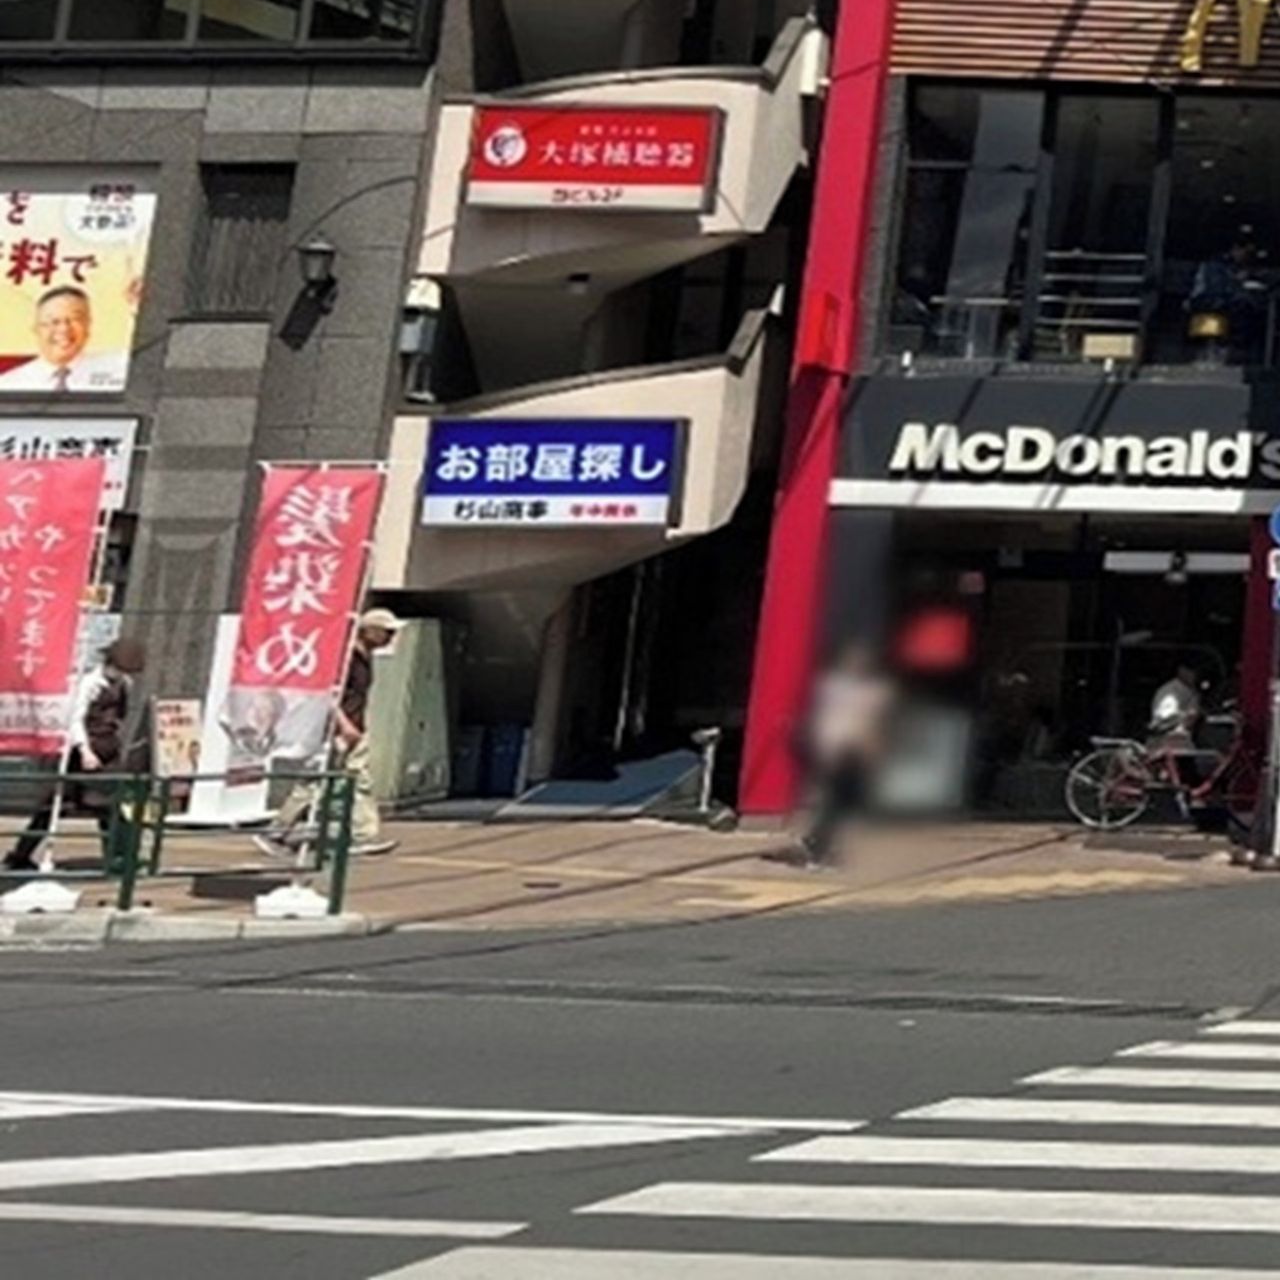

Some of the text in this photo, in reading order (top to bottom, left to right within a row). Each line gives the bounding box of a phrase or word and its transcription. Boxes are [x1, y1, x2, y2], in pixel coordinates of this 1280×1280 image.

[436, 443, 666, 482] お部屋探し
[454, 499, 548, 520] 杉山商事
